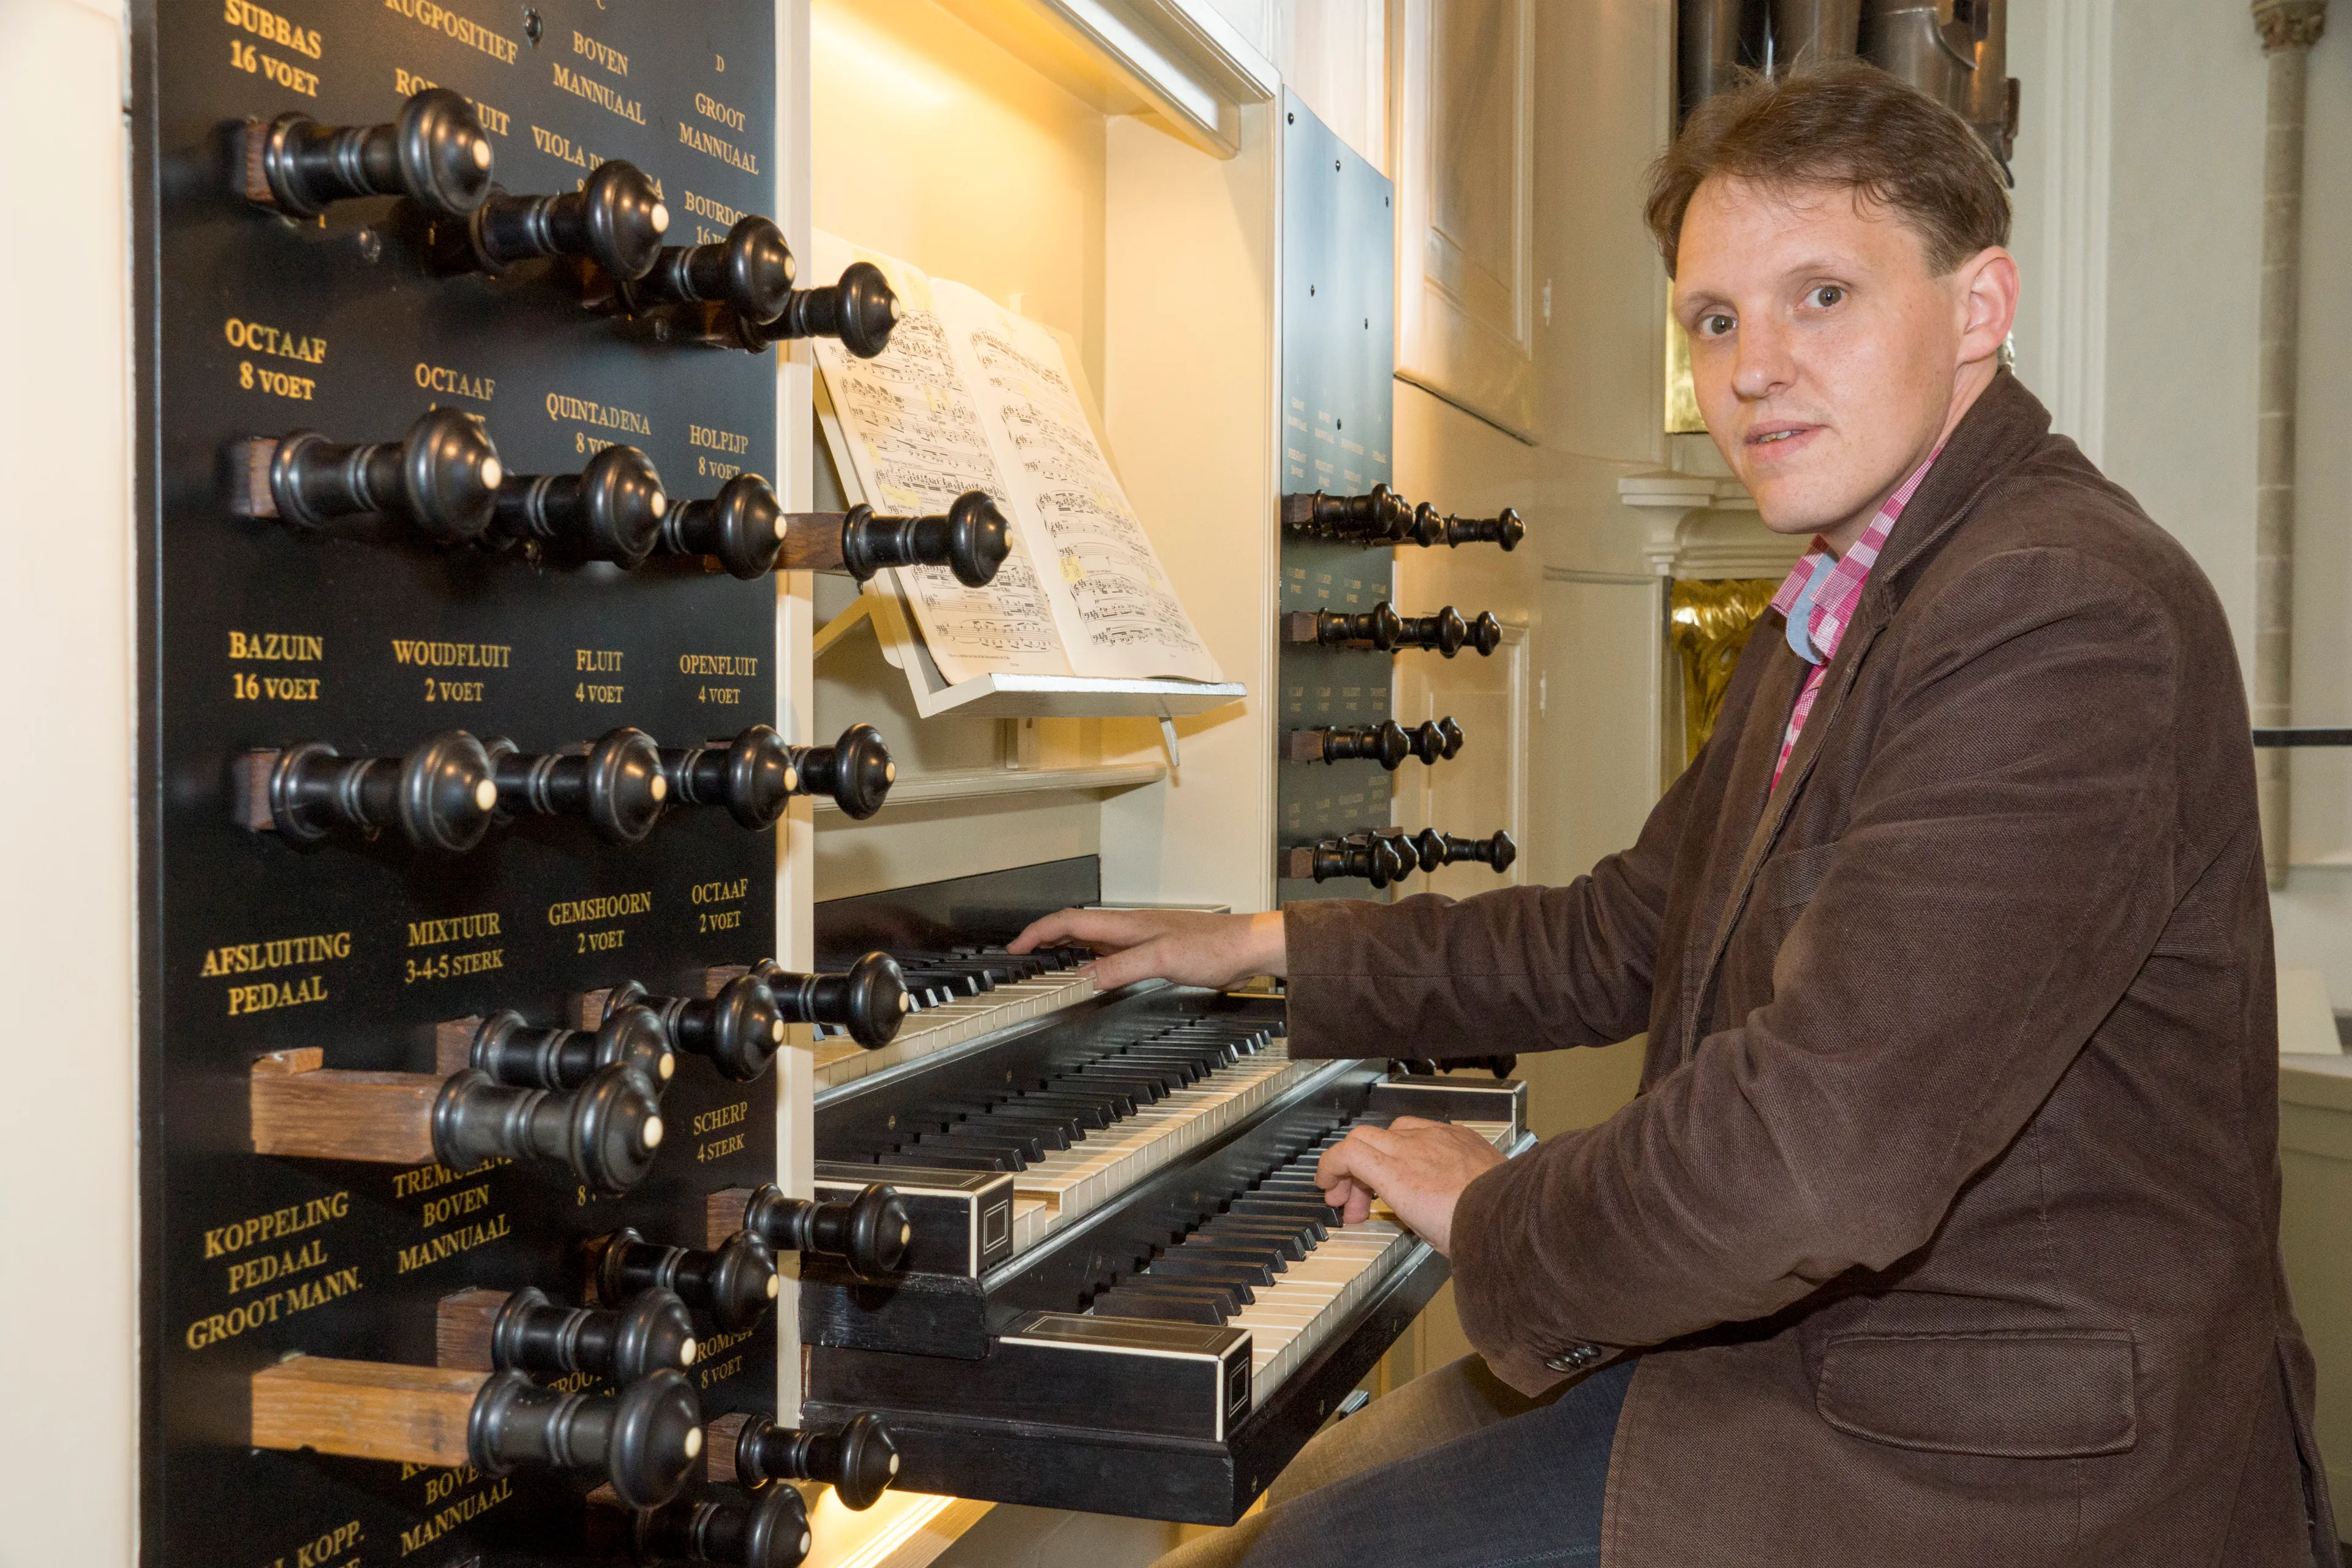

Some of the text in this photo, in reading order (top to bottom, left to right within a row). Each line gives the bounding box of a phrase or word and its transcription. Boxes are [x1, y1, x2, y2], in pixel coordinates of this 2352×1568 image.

[224, 0, 322, 59] SUBBAS
[230, 40, 319, 98] 16 VOET
[573, 31, 628, 77] BOVEN
[715, 55, 725, 72] D
[553, 63, 646, 126] MANNUAAL
[695, 93, 745, 132] GROOT
[531, 125, 586, 167] VIOLA
[679, 123, 759, 175] MANNUAAL
[685, 191, 748, 227] BOURDO
[224, 318, 327, 363] OCTAAF
[239, 361, 315, 400] 8 VOET
[414, 363, 496, 401] OCTAAF
[546, 393, 651, 435] QUINTADENA
[576, 432, 585, 453] 8
[690, 424, 748, 454] HOLPIJP
[698, 456, 706, 476] 8
[228, 631, 324, 661] BAZUIN
[391, 639, 511, 668] WOUDFLUIT
[576, 649, 624, 672] FLUIT
[679, 655, 758, 676] OPENFLUIT
[233, 673, 320, 701] 16 VOET
[425, 677, 484, 702] 2 VOET
[575, 682, 624, 703] 4 VOET
[698, 686, 741, 704] 4 VOET
[548, 891, 652, 926] GEMSHOORN
[692, 878, 748, 905] OCTAAF
[407, 912, 502, 947] MIXTUUR
[699, 910, 741, 933] 2 VOET
[200, 931, 352, 978] AFSLUITING
[577, 929, 625, 954] 2 VOET
[404, 949, 504, 984] 3-4-5 STERK
[227, 975, 329, 1017] PEDAAL
[693, 1101, 748, 1136] SCHERP
[697, 1134, 745, 1163] 4 STERK
[423, 1184, 489, 1228] BOVEN
[578, 1185, 586, 1205] 8
[203, 1191, 350, 1259] KOPPELING
[398, 1213, 511, 1274] MANNUAAL
[227, 1240, 328, 1294] PEDAAL
[186, 1266, 363, 1350] GROOT MANN.
[701, 1355, 742, 1389] 8 VOET
[425, 1464, 480, 1506] BOVE
[401, 1477, 513, 1557] MANNUAAL
[298, 1520, 365, 1568] KOPP.
